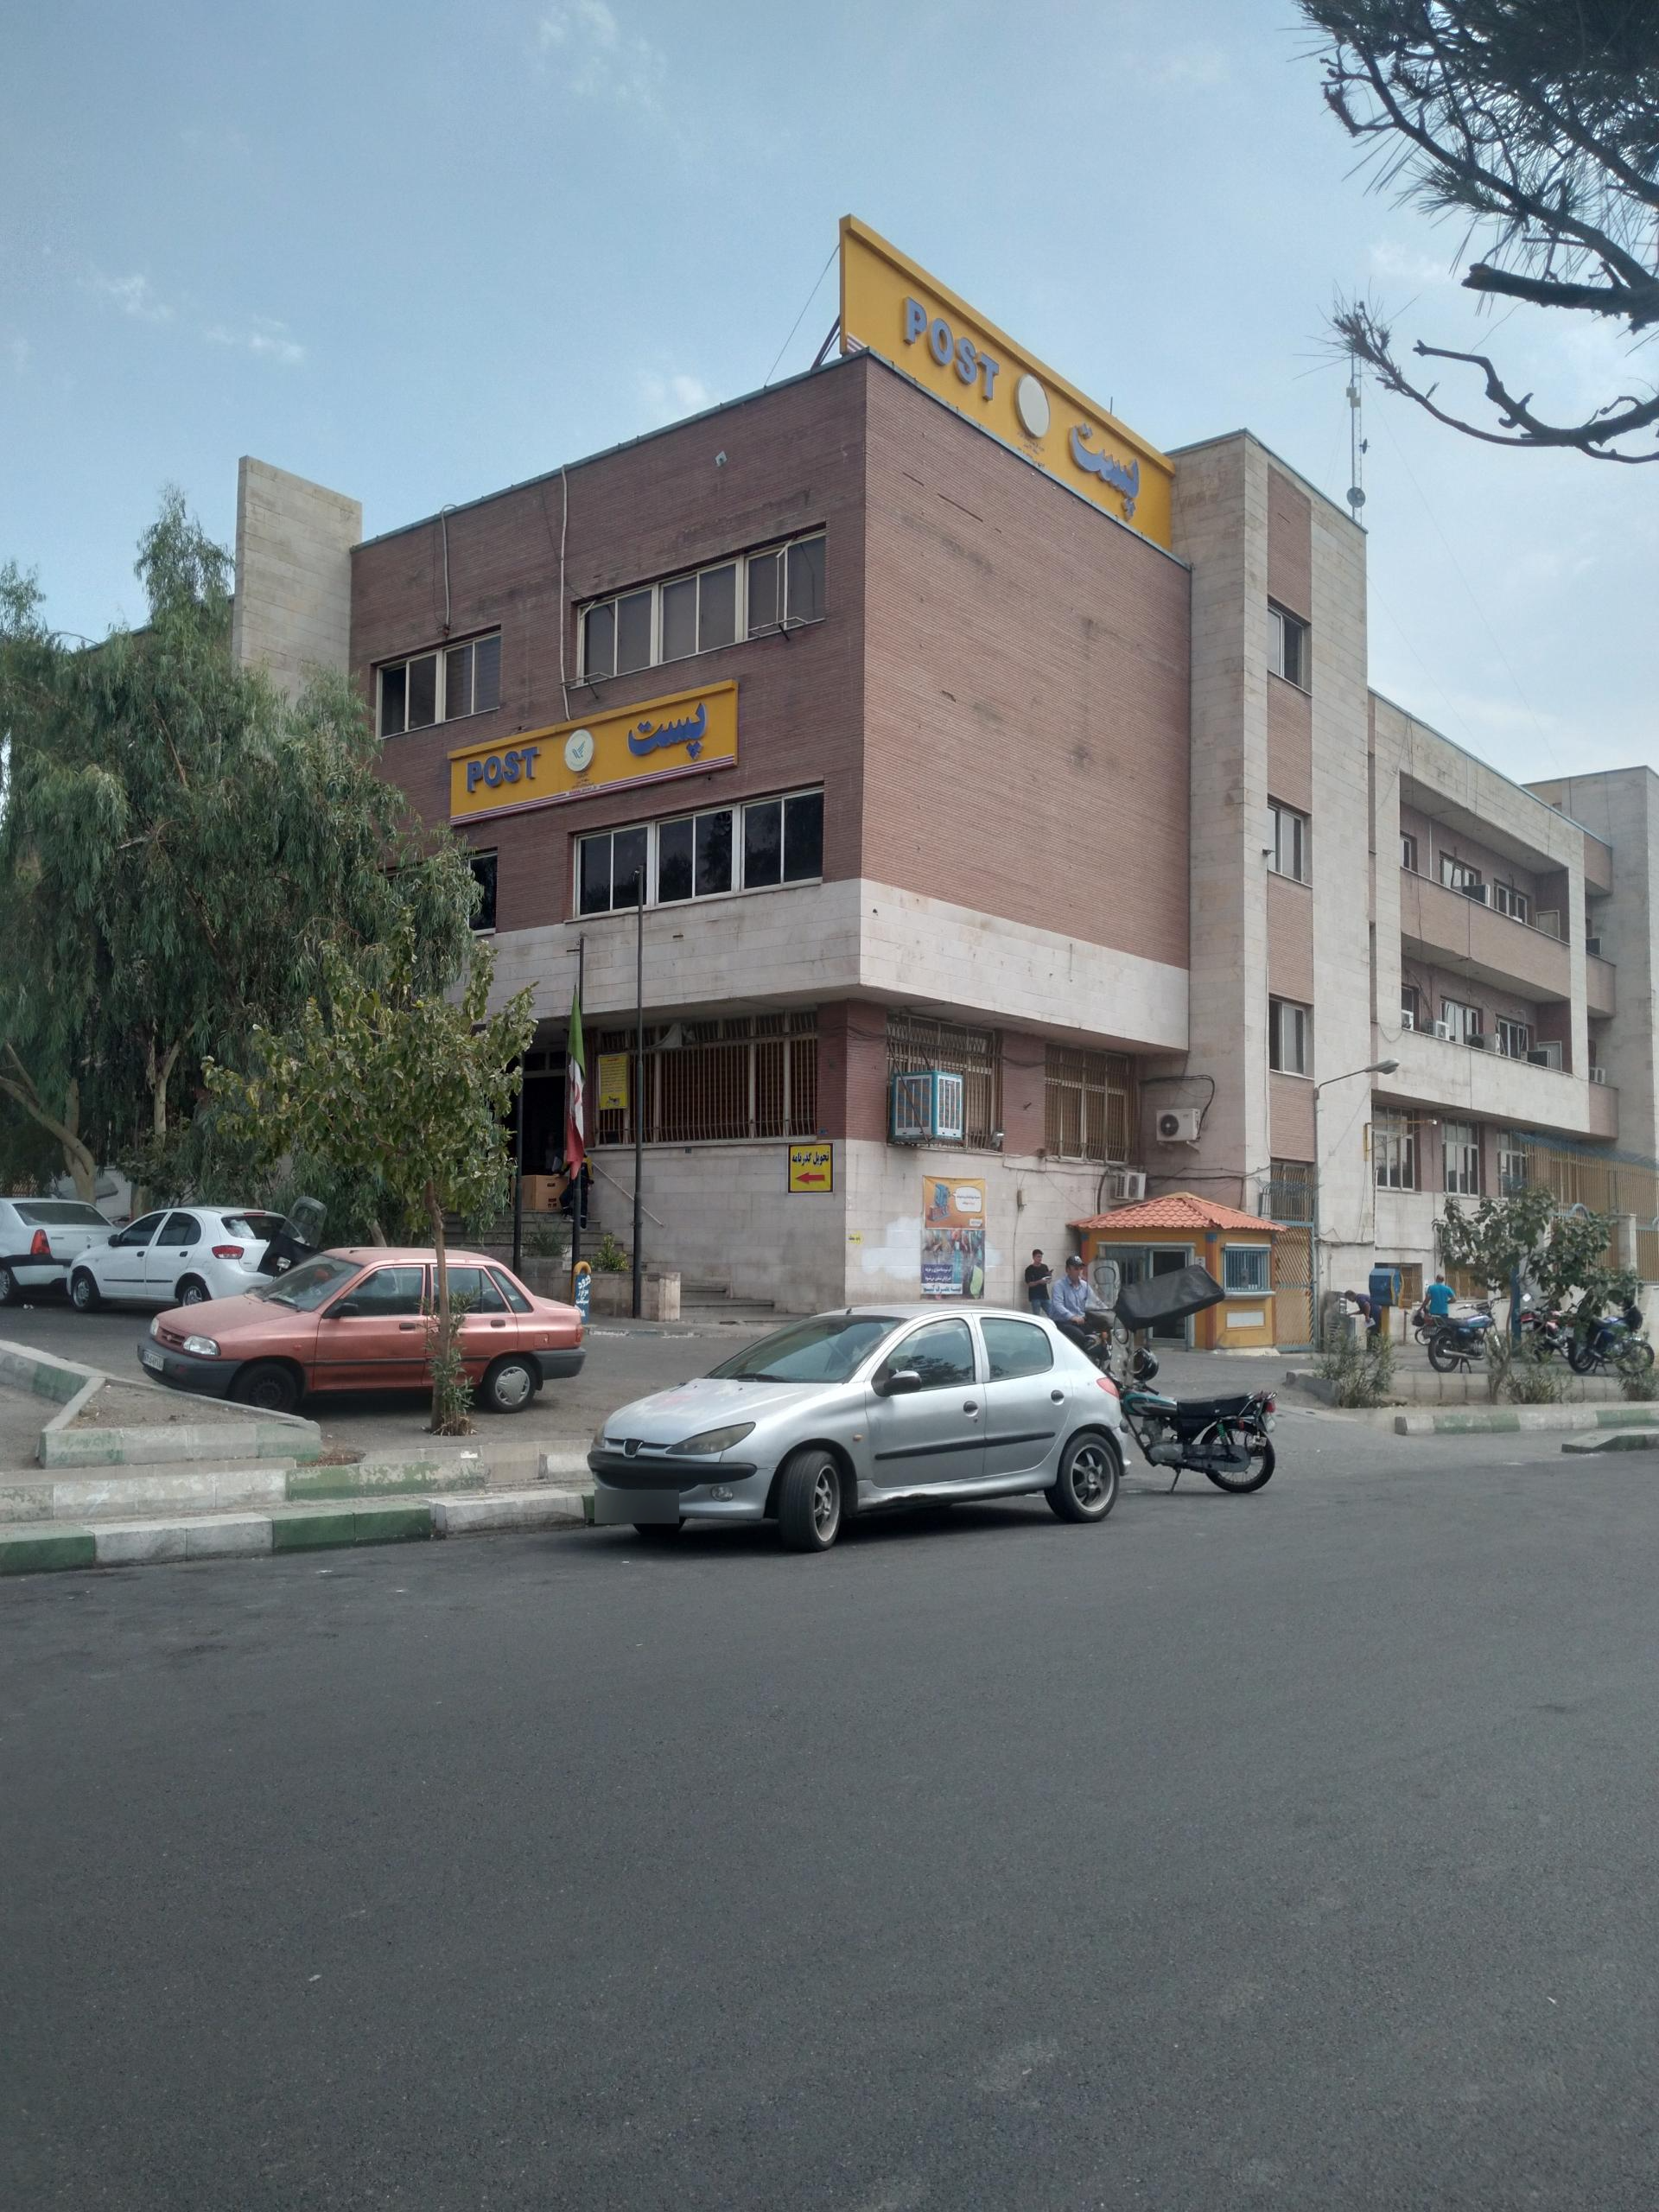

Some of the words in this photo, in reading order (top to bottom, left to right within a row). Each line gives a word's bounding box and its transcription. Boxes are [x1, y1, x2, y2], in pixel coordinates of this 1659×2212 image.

[903, 296, 1000, 402] POST
[1068, 423, 1141, 522] پست
[627, 702, 708, 760] پست
[467, 746, 541, 794] POST
[792, 1152, 812, 1166] گذرنامه
[813, 1151, 830, 1166] تحویل
